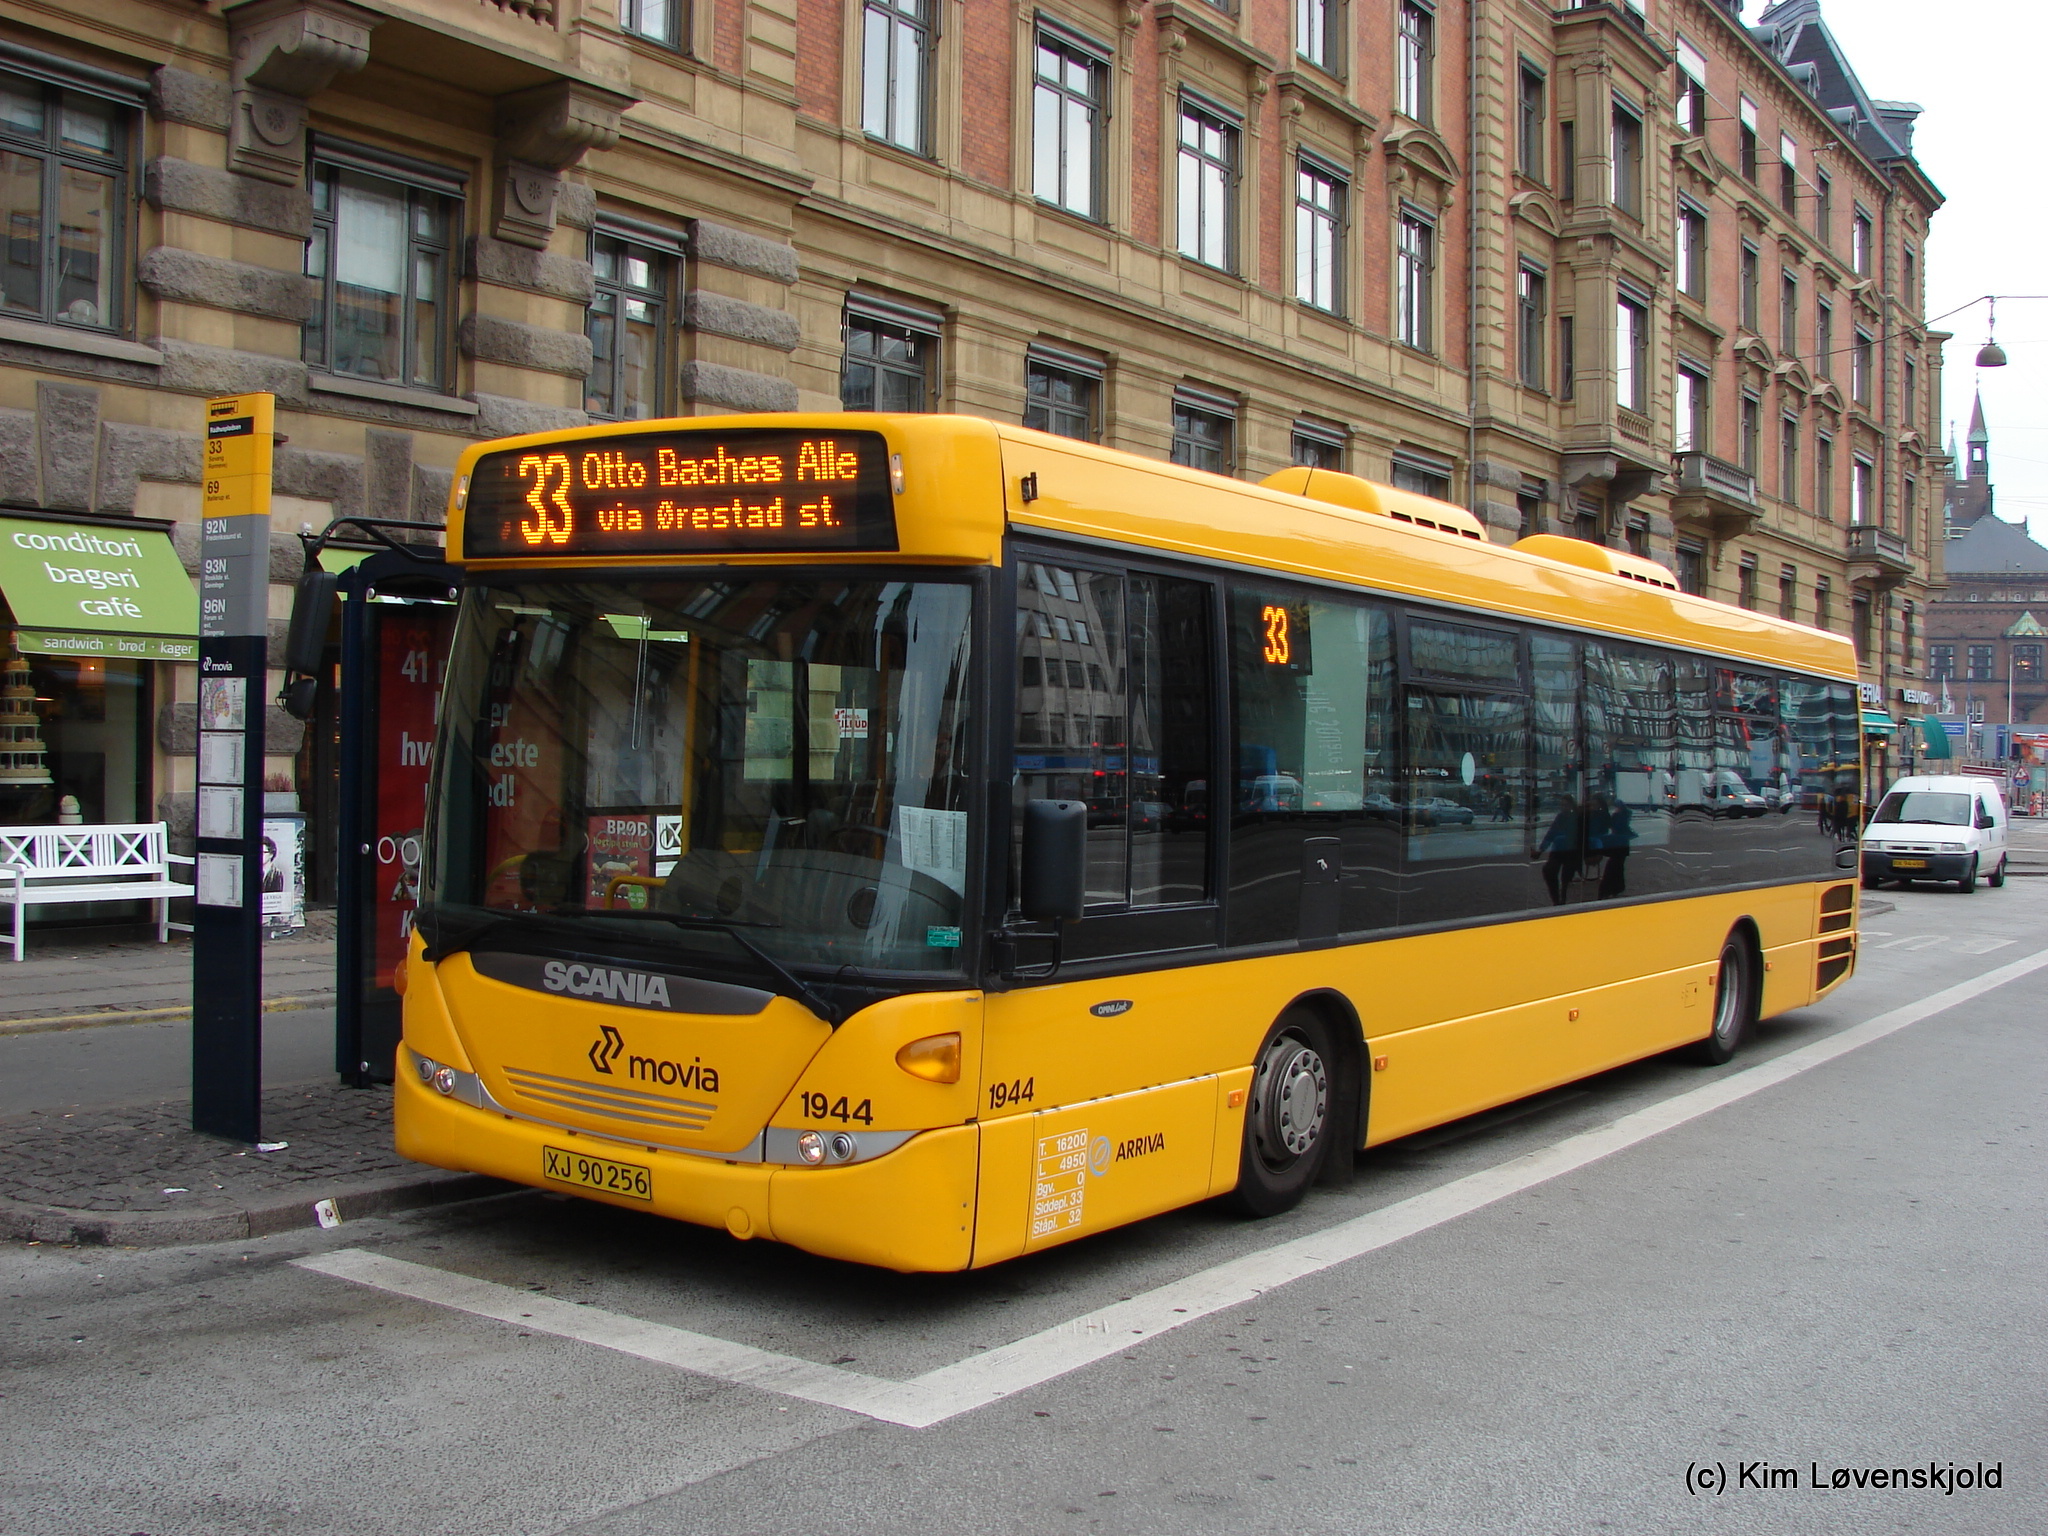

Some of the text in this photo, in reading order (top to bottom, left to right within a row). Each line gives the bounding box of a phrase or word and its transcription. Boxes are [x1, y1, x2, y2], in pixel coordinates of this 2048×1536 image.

[209, 440, 222, 454] 33
[581, 440, 858, 489] Otto Baches Alle
[207, 480, 220, 494] 69
[518, 453, 573, 546] 33
[206, 519, 227, 535] 92N
[597, 495, 842, 532] via Ørestad st.
[12, 530, 144, 559] conditori
[44, 562, 141, 590] bageri
[205, 559, 227, 574] 93N
[80, 597, 144, 619] café
[204, 599, 226, 614] 96N
[44, 635, 194, 657] sandwich brød kager
[1263, 605, 1289, 664] 33
[211, 661, 233, 671] movia
[401, 650, 429, 684] 41
[607, 819, 648, 837] BRØD
[543, 960, 672, 1008] SCANIA
[628, 1056, 720, 1093] movia
[988, 1077, 1035, 1110] 1944
[800, 1090, 874, 1126] 1944
[1056, 1132, 1087, 1152] 16200
[1115, 1132, 1165, 1162] ARRIVA
[547, 1150, 572, 1178] XJ
[1059, 1152, 1086, 1170] 4950
[1037, 1171, 1084, 1197] Bgv. 0
[1035, 1190, 1083, 1217] Siddepl. 33
[1033, 1208, 1081, 1235] Ståpl. 32
